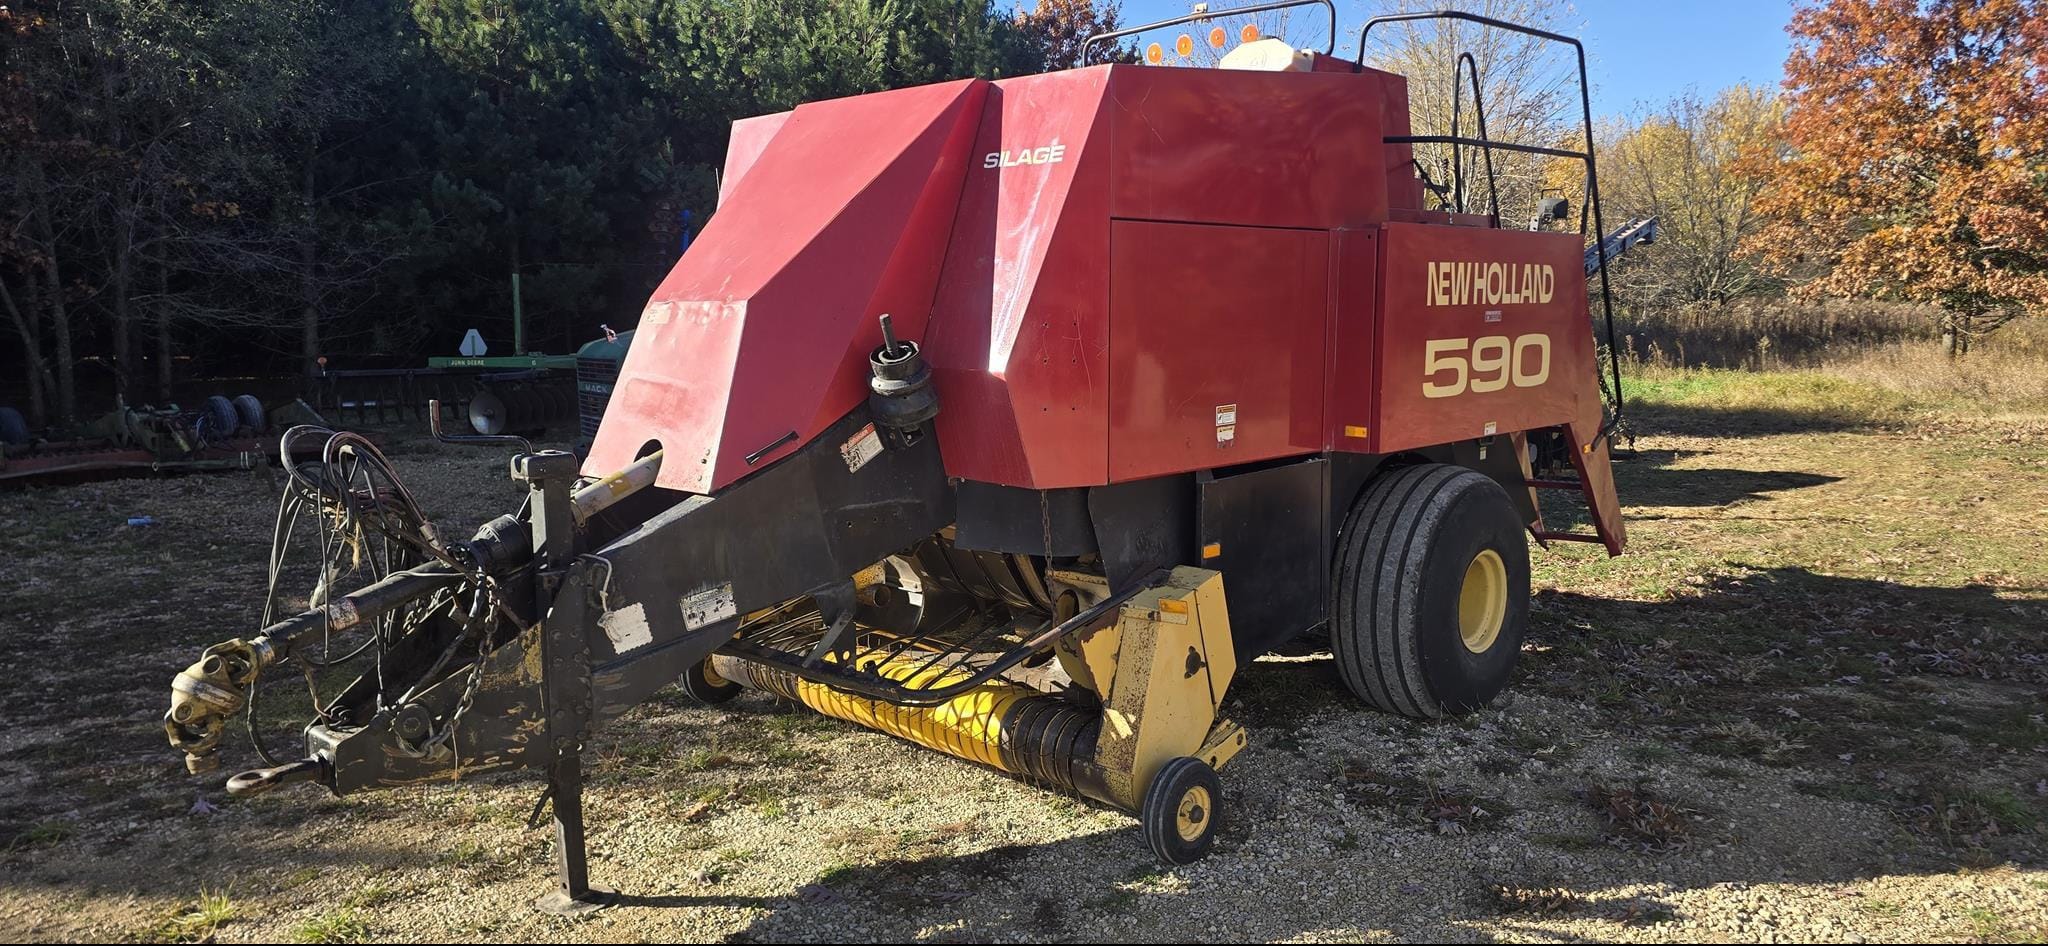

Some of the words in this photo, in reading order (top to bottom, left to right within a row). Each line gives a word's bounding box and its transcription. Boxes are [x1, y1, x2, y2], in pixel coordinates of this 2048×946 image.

[984, 145, 1066, 168] SILAGE
[1427, 262, 1472, 306] NEW
[1473, 262, 1554, 305] HOLLAND
[1422, 333, 1551, 398] 590
[585, 383, 608, 393] MACK
